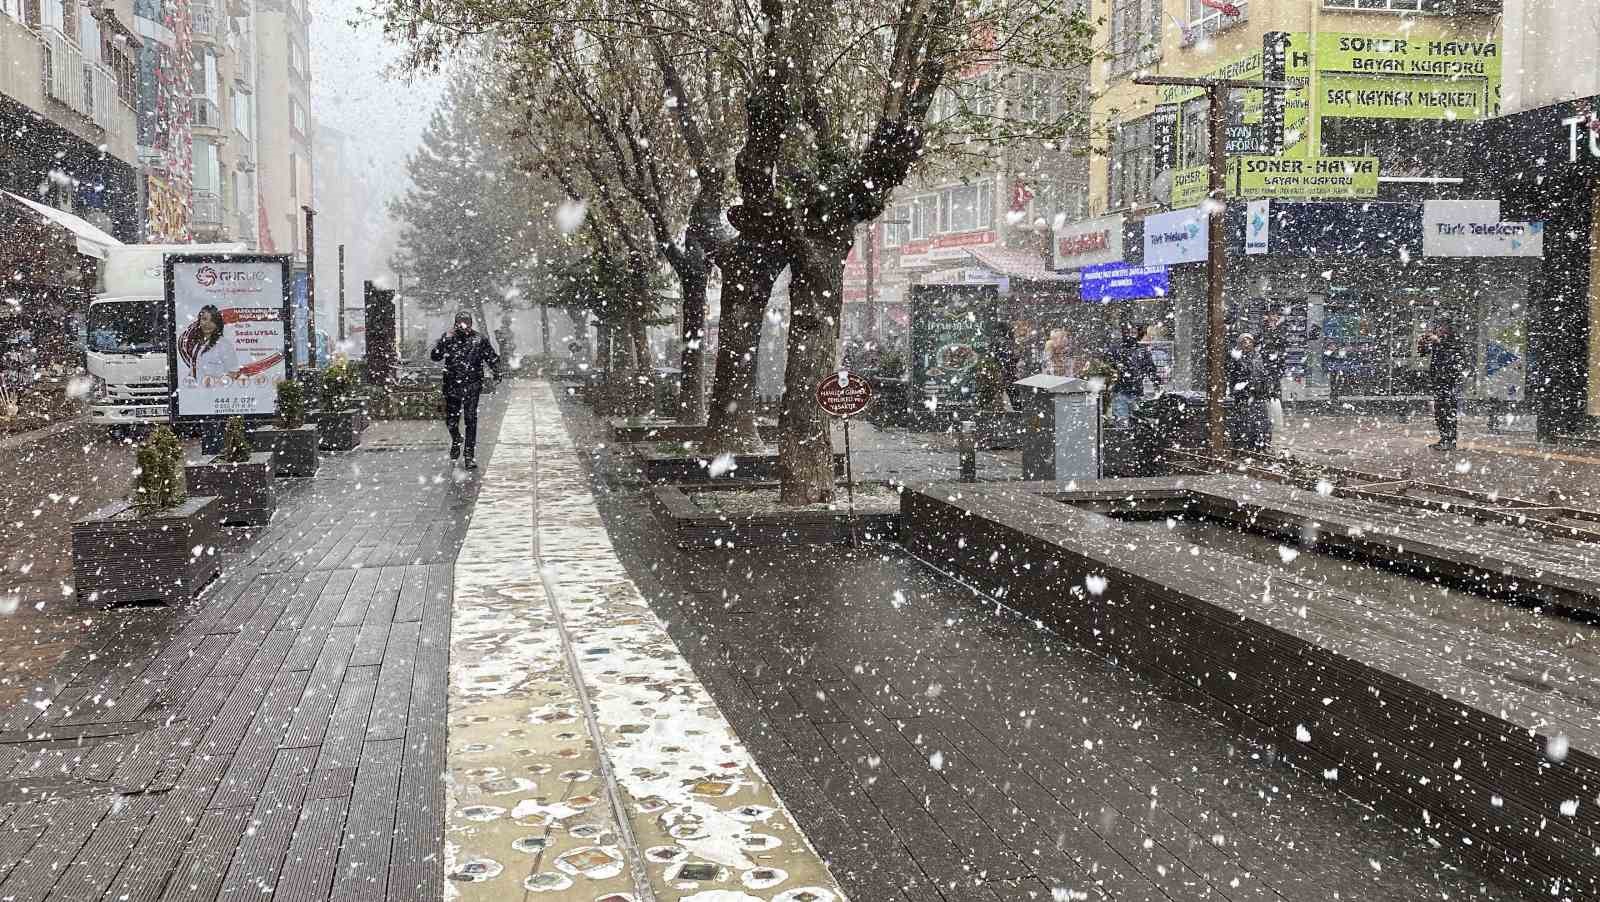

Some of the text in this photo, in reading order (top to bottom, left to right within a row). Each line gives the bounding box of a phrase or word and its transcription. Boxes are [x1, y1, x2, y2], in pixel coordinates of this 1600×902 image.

[1429, 41, 1496, 57] HAVVA
[1352, 58, 1404, 71] BAYAN
[1328, 89, 1352, 108] SAÇ
[1357, 89, 1413, 107] KAYNAK
[1247, 160, 1303, 173] SONER
[1316, 160, 1373, 173] HAVVA
